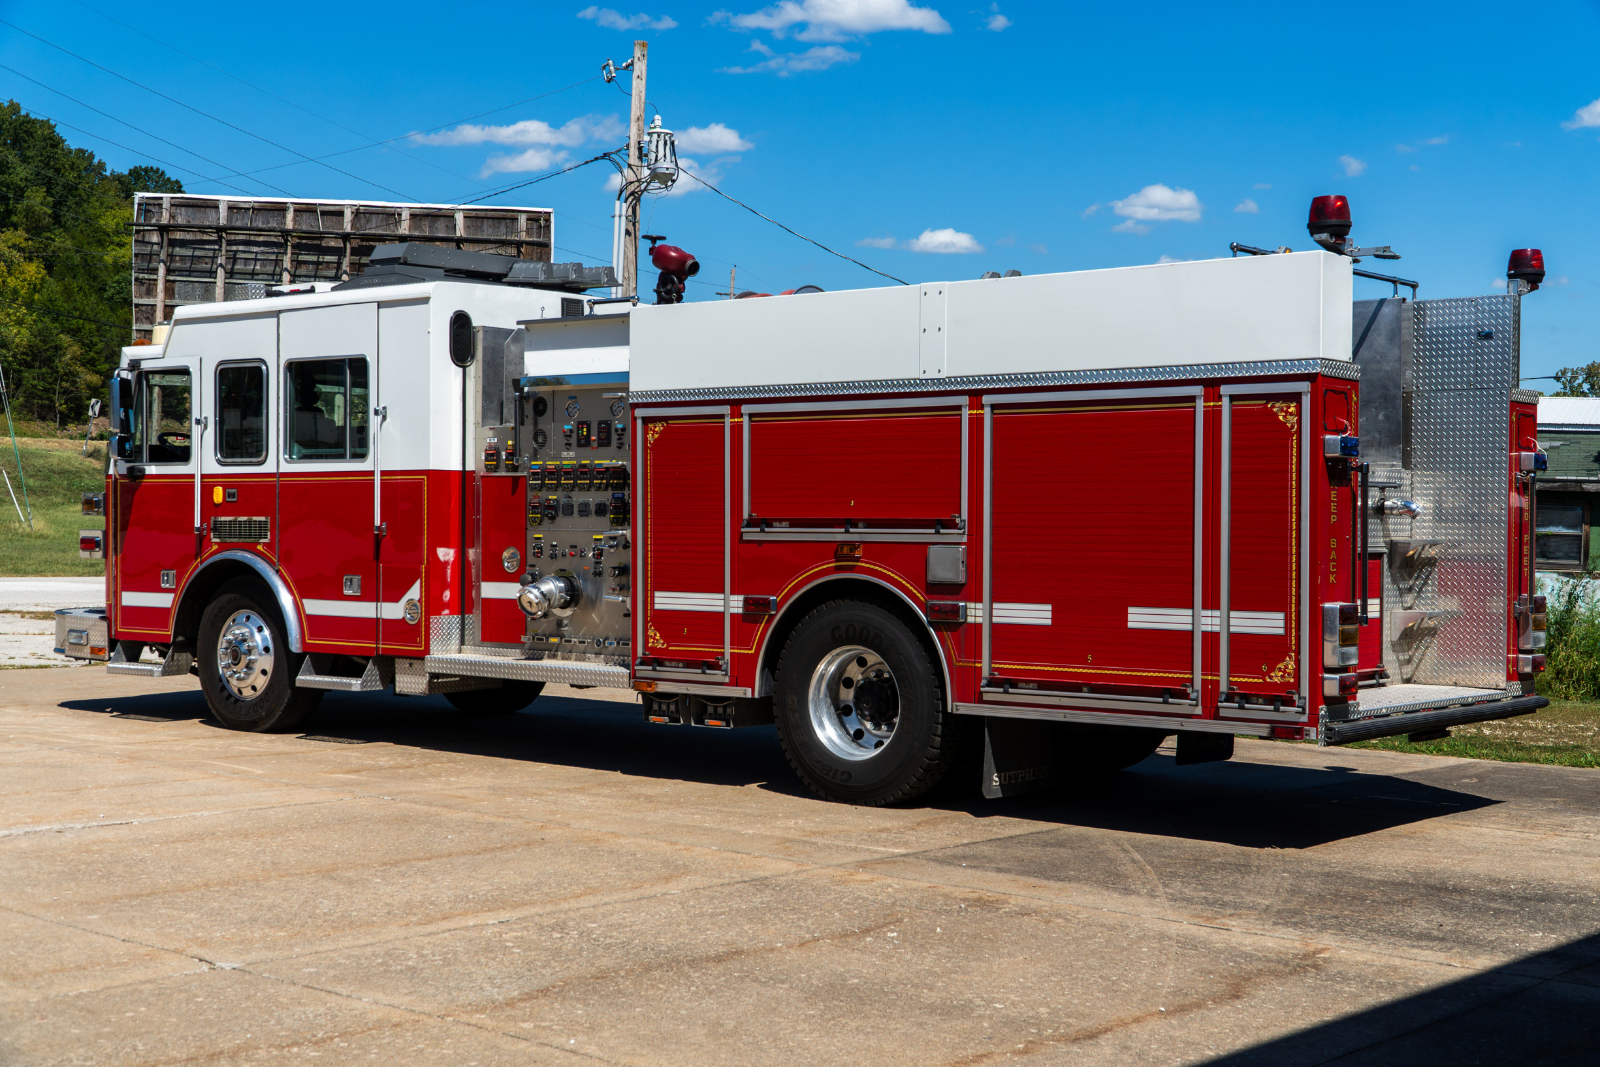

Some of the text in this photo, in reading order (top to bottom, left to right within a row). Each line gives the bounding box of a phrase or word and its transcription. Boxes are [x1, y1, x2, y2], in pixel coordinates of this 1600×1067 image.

[849, 499, 854, 507] 4
[1329, 479, 1338, 584] KEEP BACK
[1087, 654, 1092, 663] 5
[1261, 662, 1268, 672] 6
[806, 751, 853, 783] G182
[992, 765, 1050, 786] SUTPHEN
